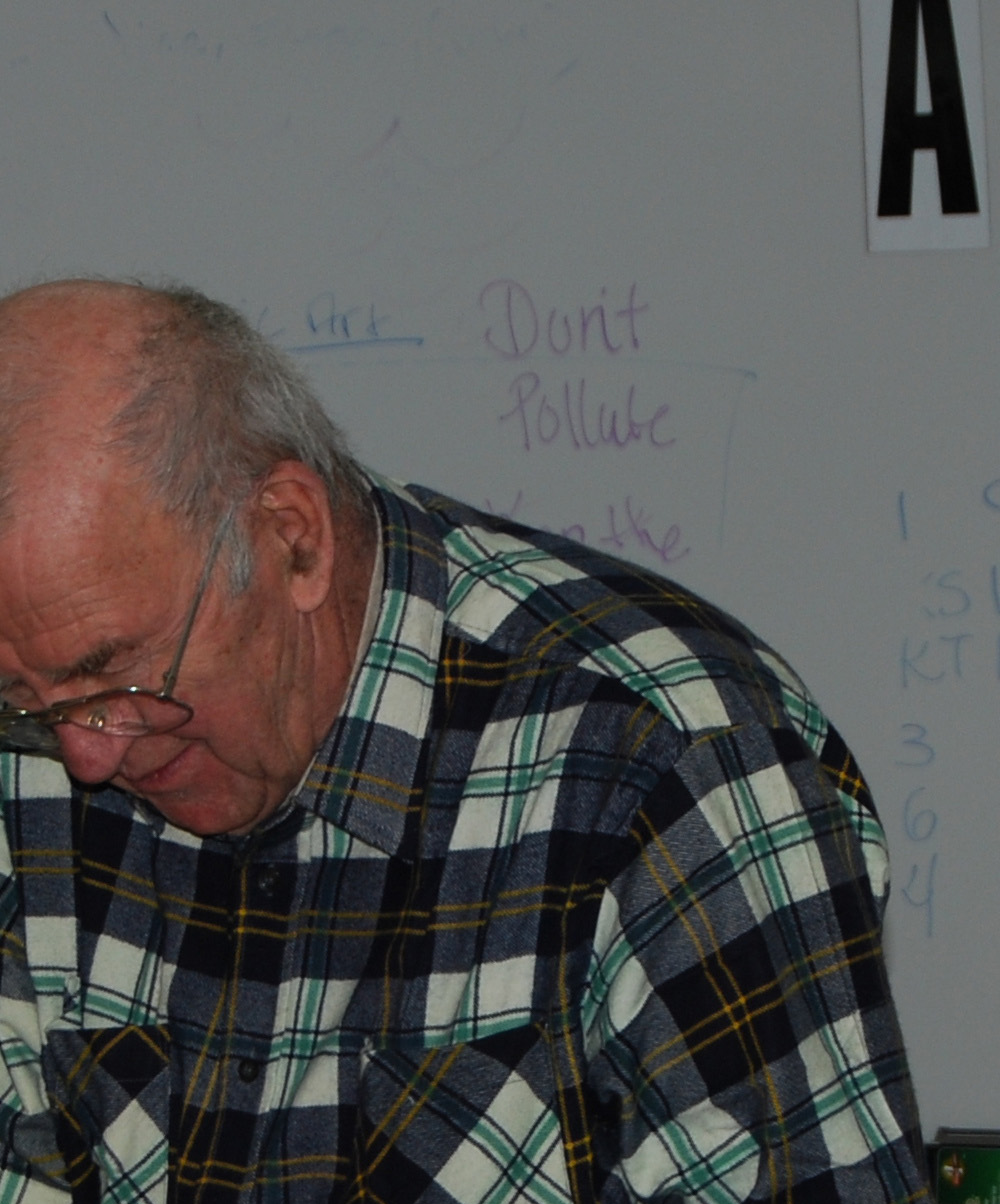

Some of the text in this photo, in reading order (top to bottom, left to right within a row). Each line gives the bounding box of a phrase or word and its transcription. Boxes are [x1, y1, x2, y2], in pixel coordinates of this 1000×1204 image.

[878, 0, 980, 217] A
[499, 370, 677, 452] Pollute
[600, 494, 692, 565] the
